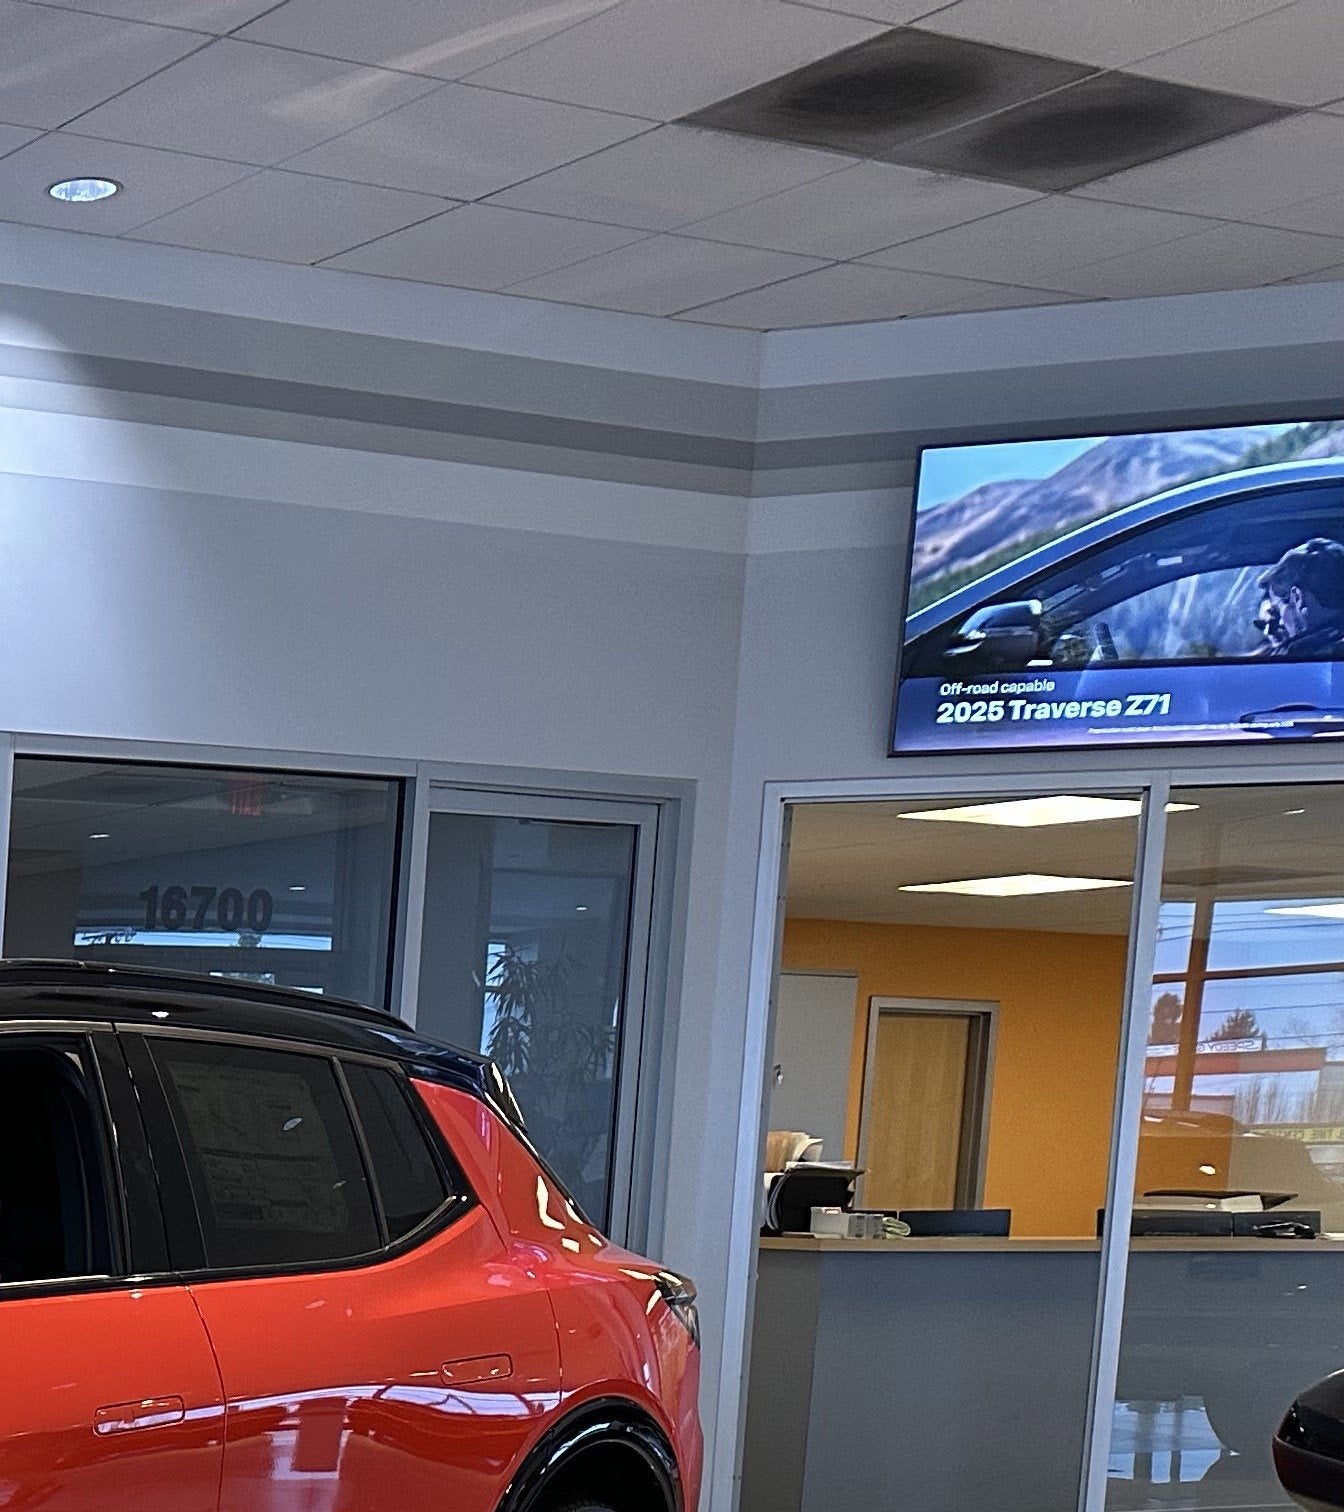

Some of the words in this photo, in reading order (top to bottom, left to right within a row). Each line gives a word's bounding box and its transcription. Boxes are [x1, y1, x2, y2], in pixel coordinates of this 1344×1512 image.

[940, 681, 999, 696] Off-road
[1001, 679, 1055, 694] capable
[936, 700, 1005, 724] 2025
[1009, 698, 1122, 720] Traverse
[1124, 694, 1171, 716] Z71
[139, 884, 273, 932] 16700
